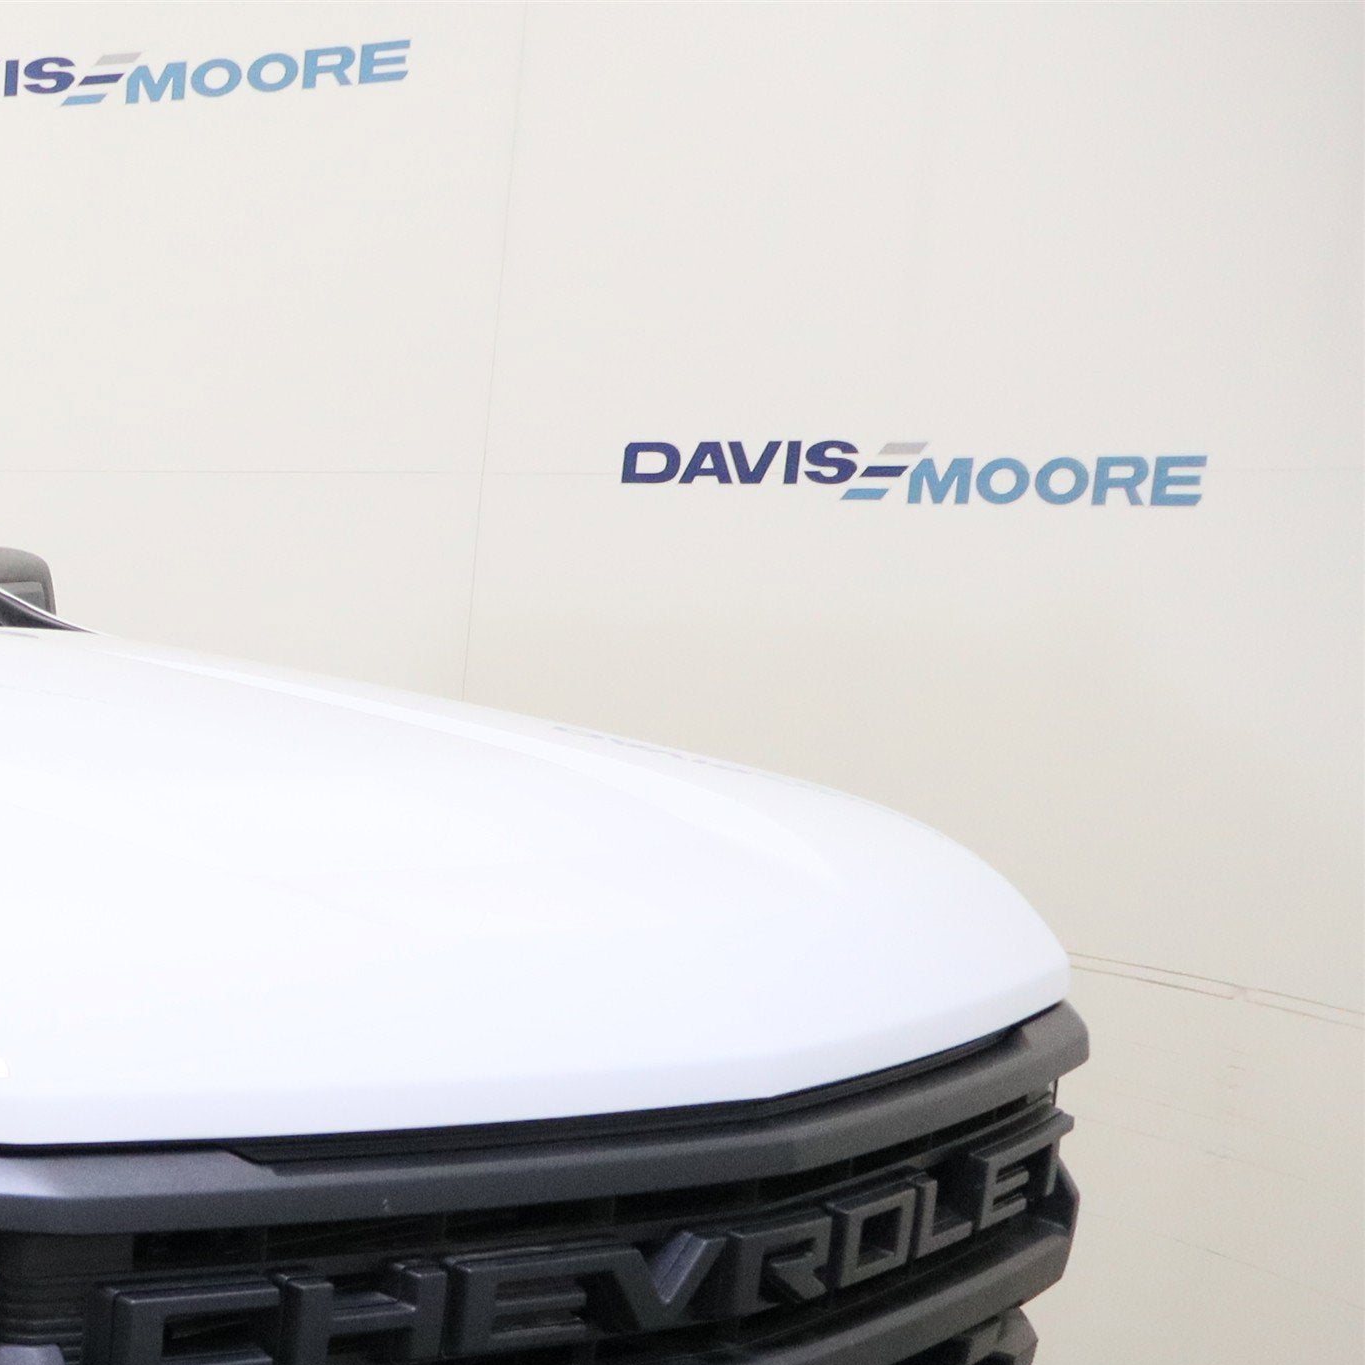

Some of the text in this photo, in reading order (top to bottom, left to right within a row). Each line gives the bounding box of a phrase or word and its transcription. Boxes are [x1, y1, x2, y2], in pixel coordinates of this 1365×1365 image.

[125, 38, 411, 105] MOORE
[620, 440, 1208, 507] DAVIS MOORE
